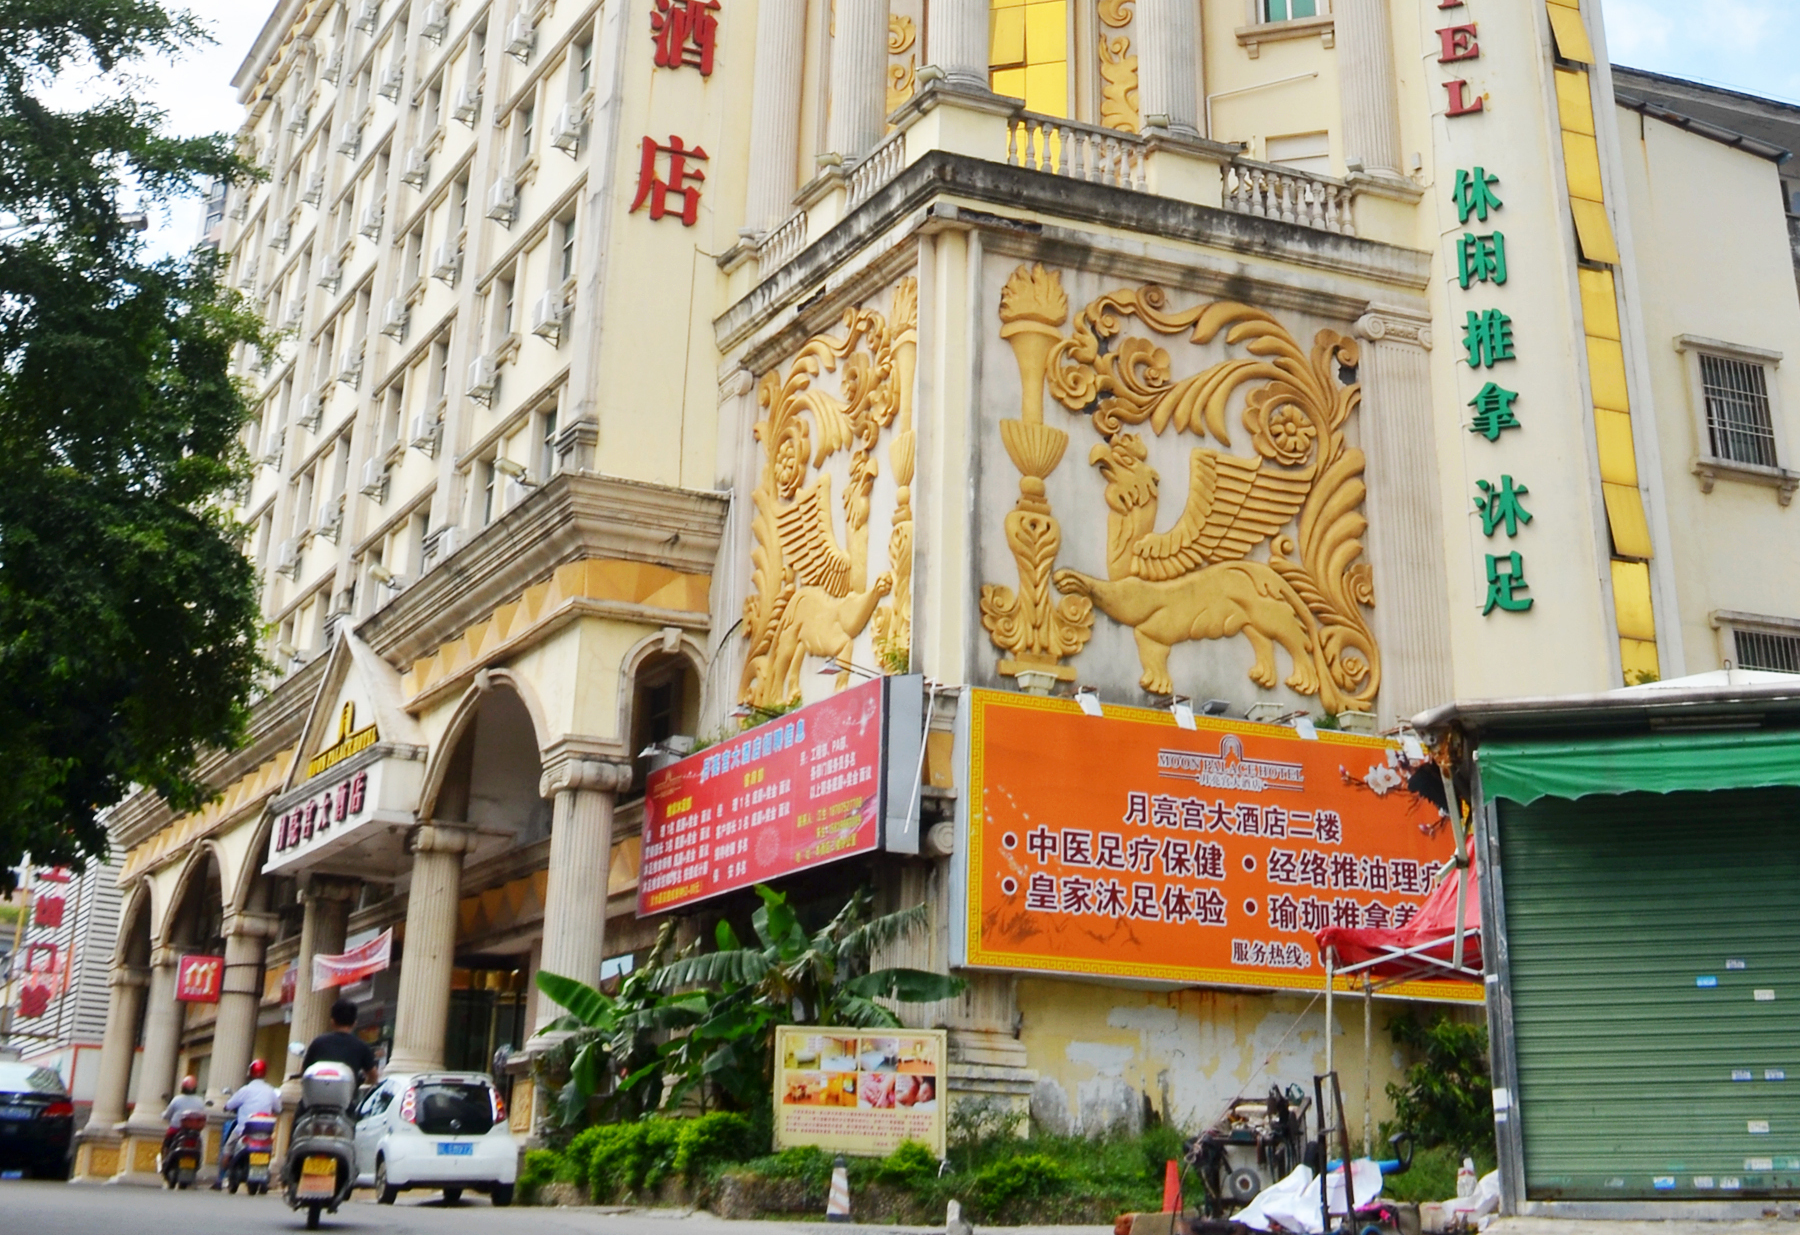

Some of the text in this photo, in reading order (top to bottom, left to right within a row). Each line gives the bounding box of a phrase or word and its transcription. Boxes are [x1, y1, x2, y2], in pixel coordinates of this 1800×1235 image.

[1158, 752, 1304, 781] MOON PALACE HOTEL
[1200, 773, 1262, 792] 月亮宫大酒店
[276, 770, 367, 853] 月亮宫大酒店
[1124, 792, 1342, 844] 月亮宫大酒店二楼
[1027, 825, 1226, 880] 中医足疗保健
[1026, 872, 1227, 926] 皇家沐足体验
